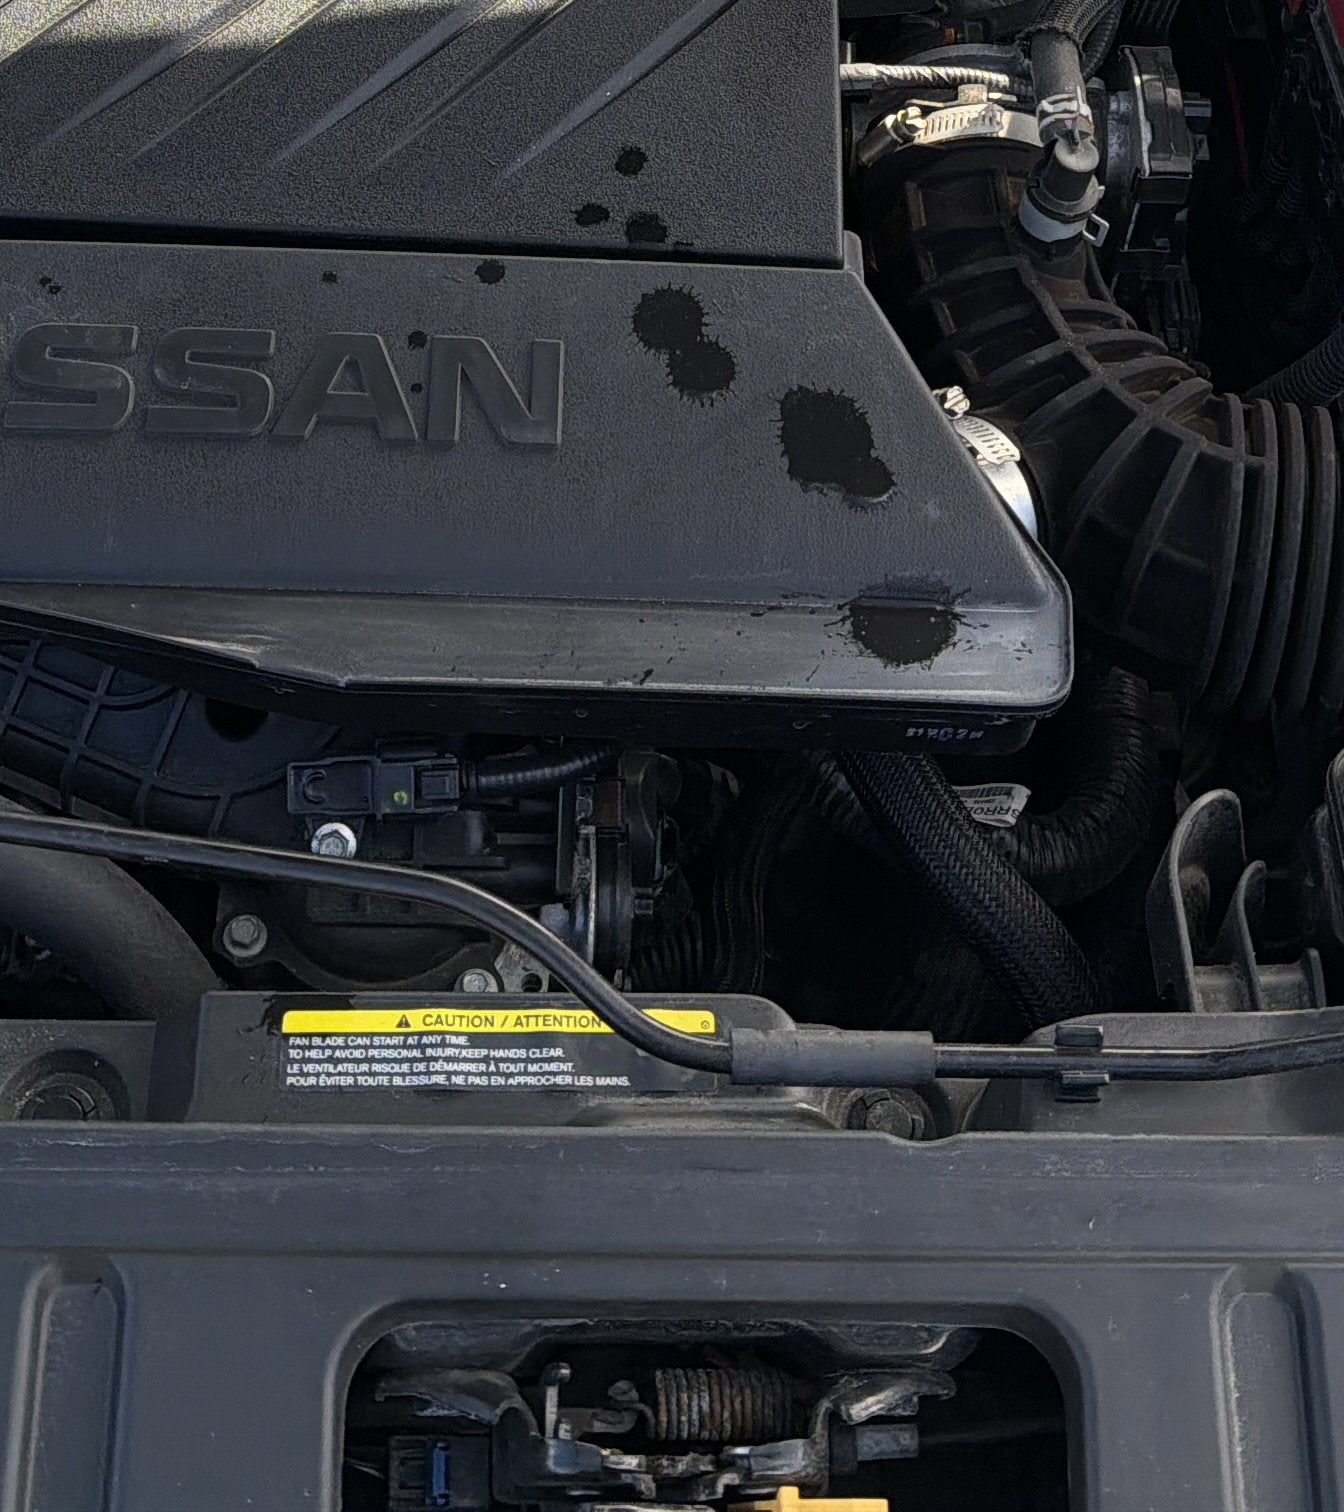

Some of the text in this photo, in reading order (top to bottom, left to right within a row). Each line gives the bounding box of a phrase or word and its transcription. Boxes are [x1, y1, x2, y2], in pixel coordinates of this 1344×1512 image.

[422, 1014, 602, 1028] CAUTION / ATTENTION
[289, 1035, 470, 1046] FAN BLADE CAN START AT ANY TIME.
[288, 1049, 302, 1059] TO
[305, 1049, 332, 1059] HELP
[334, 1049, 366, 1058] AVOID
[368, 1048, 424, 1058] PERSONAL
[490, 1048, 526, 1058] HANDS
[528, 1048, 565, 1058] CLEAR.
[287, 1060, 575, 1074] LE VENTILATEUR RISQUE DE DÉMARRER À TOUT MOMENT.
[286, 1074, 631, 1086] POUR ÉVITER TOUTE BLESSURE, NE PAS EN APPROCHER LES MAINS.
